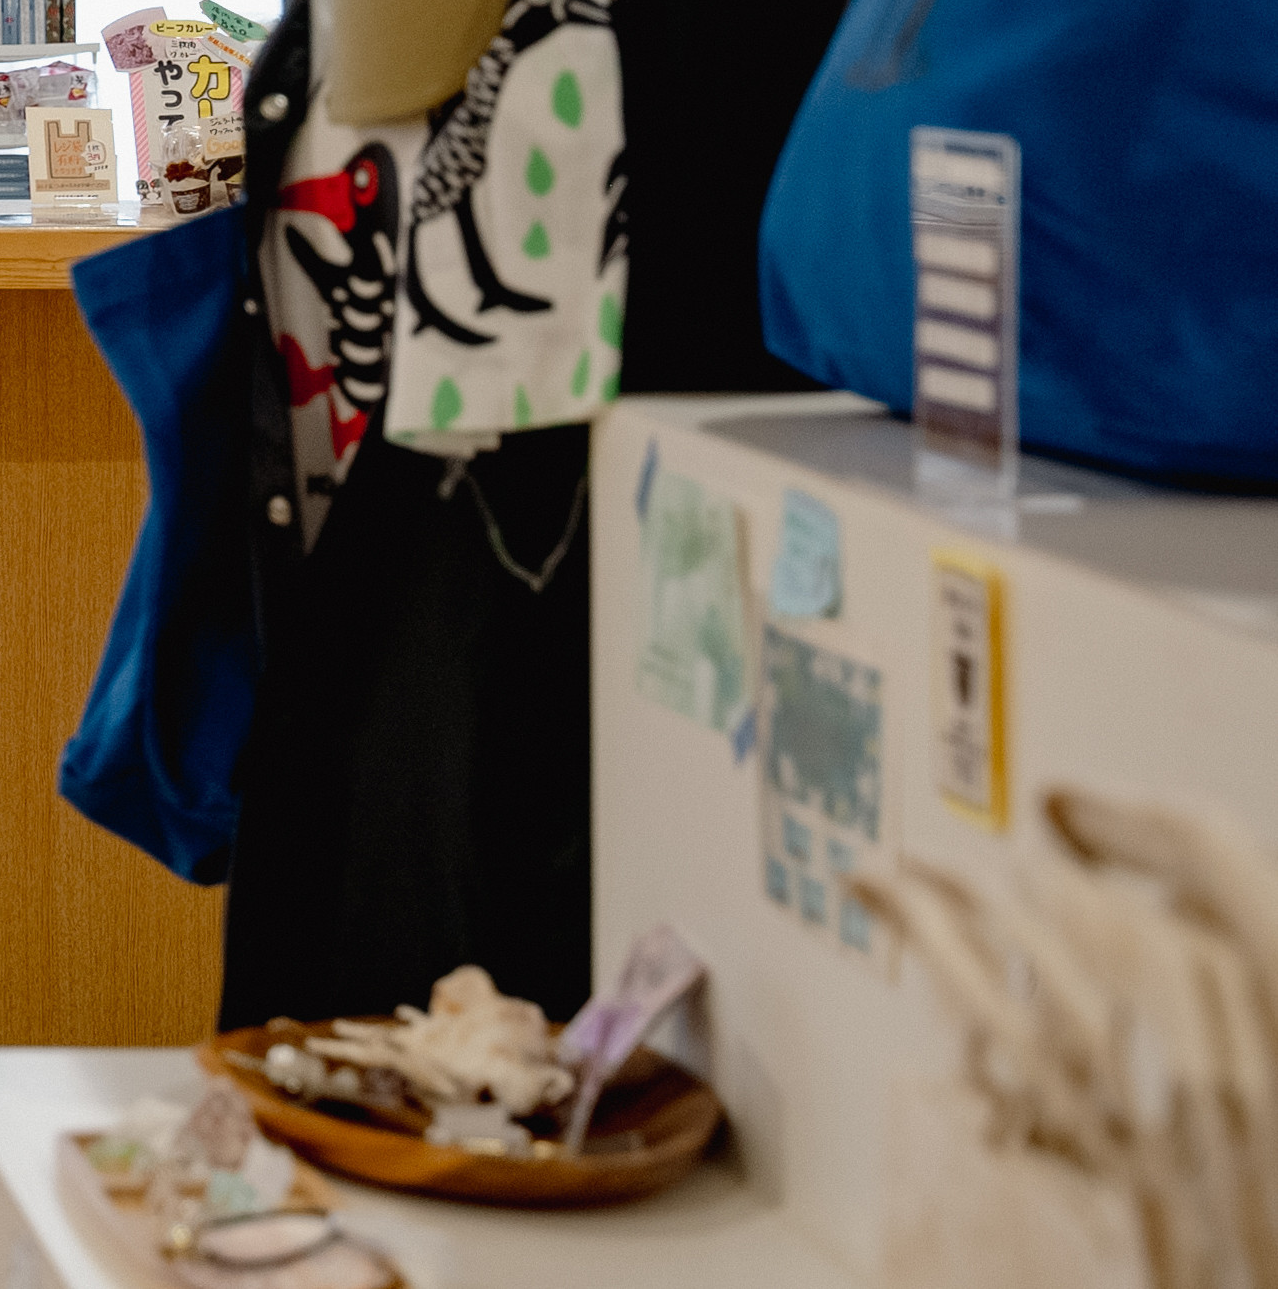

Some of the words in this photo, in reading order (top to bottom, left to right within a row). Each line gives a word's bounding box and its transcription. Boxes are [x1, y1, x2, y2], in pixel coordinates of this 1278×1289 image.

[155, 24, 213, 33] ビーフカレー
[54, 141, 83, 153] レジ袋
